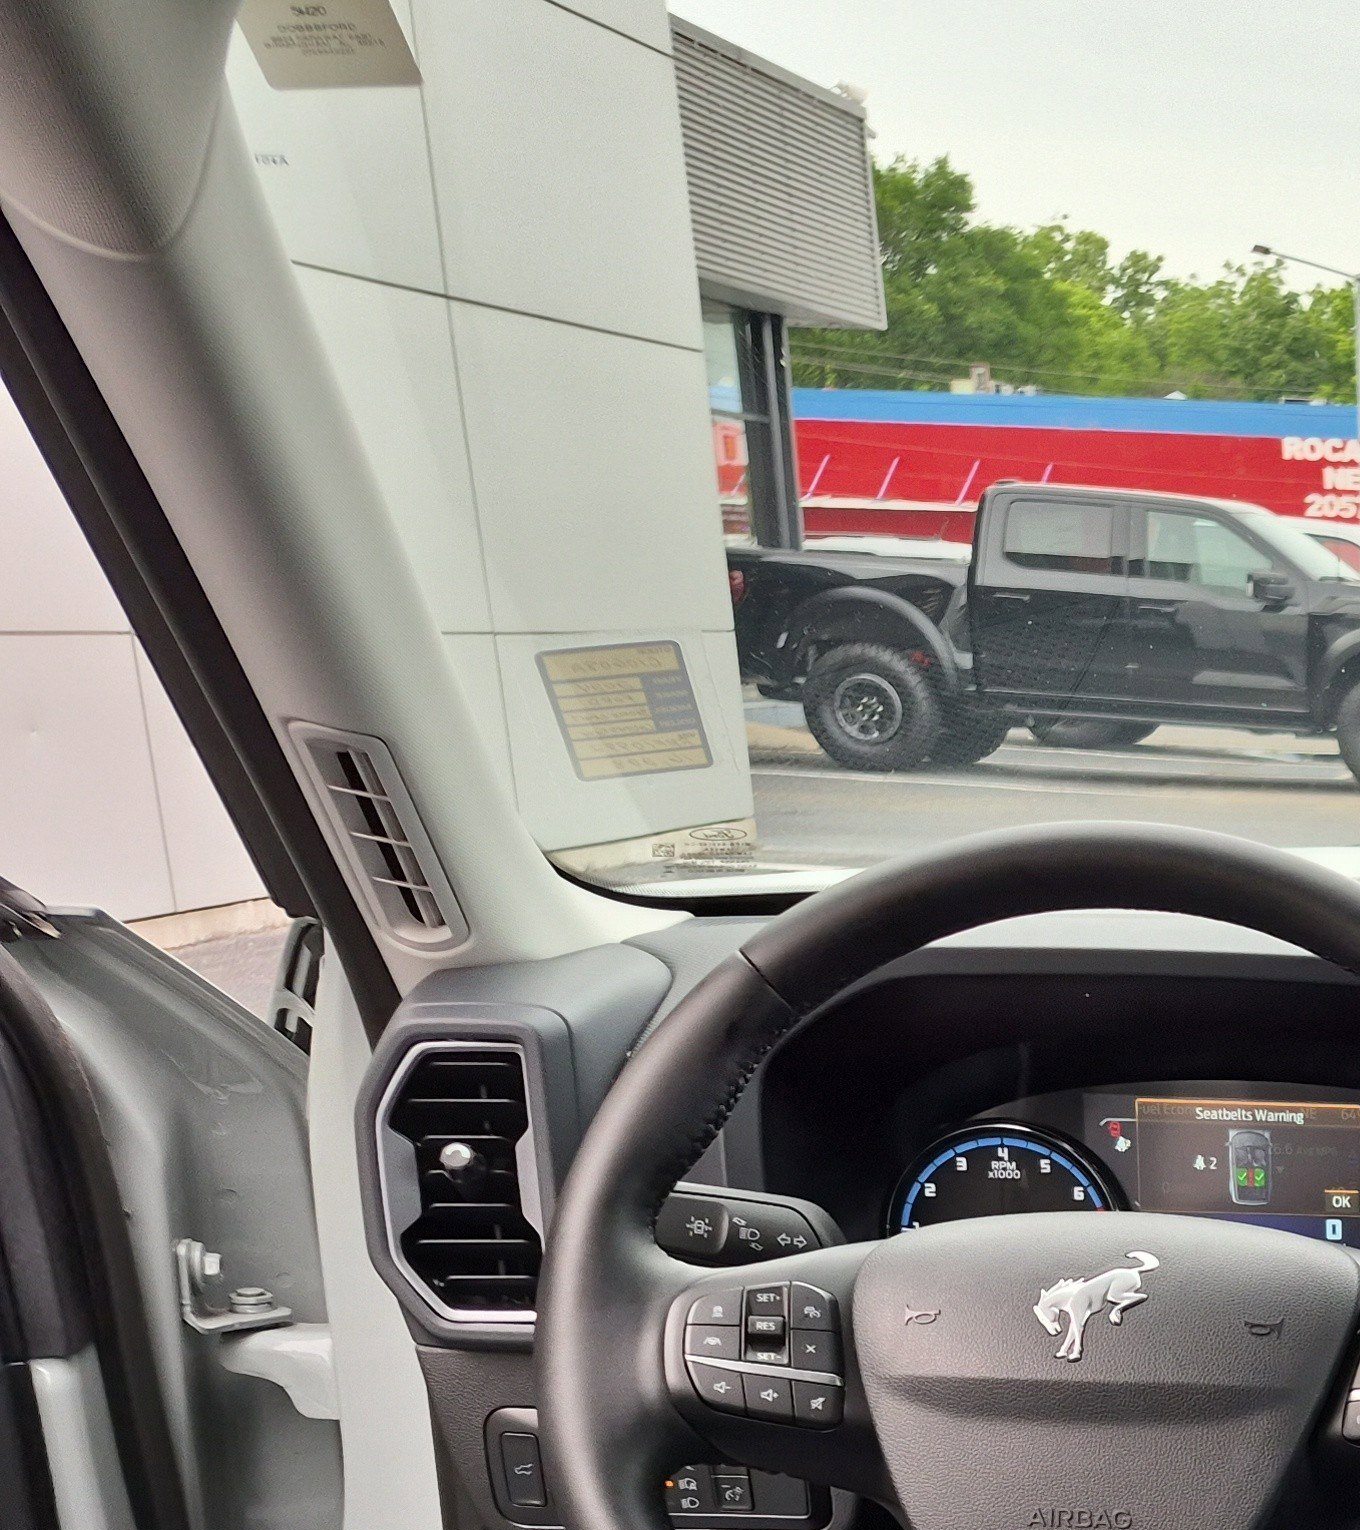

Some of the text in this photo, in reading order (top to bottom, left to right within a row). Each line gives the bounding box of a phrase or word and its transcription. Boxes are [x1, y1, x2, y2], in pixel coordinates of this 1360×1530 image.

[1195, 1107, 1253, 1121] Seatbelts
[1255, 1109, 1304, 1125] Warning
[998, 1147, 1009, 1161] 4
[956, 1157, 968, 1171] 3
[991, 1161, 1016, 1170] RPM
[1040, 1159, 1051, 1173] 5
[1210, 1157, 1217, 1170] 2
[988, 1170, 1021, 1179] x1000
[924, 1183, 937, 1197] 2
[1074, 1186, 1085, 1201] 6
[1332, 1196, 1351, 1208] OK
[756, 1321, 776, 1331] RES
[1027, 1508, 1133, 1530] AIRBAG
